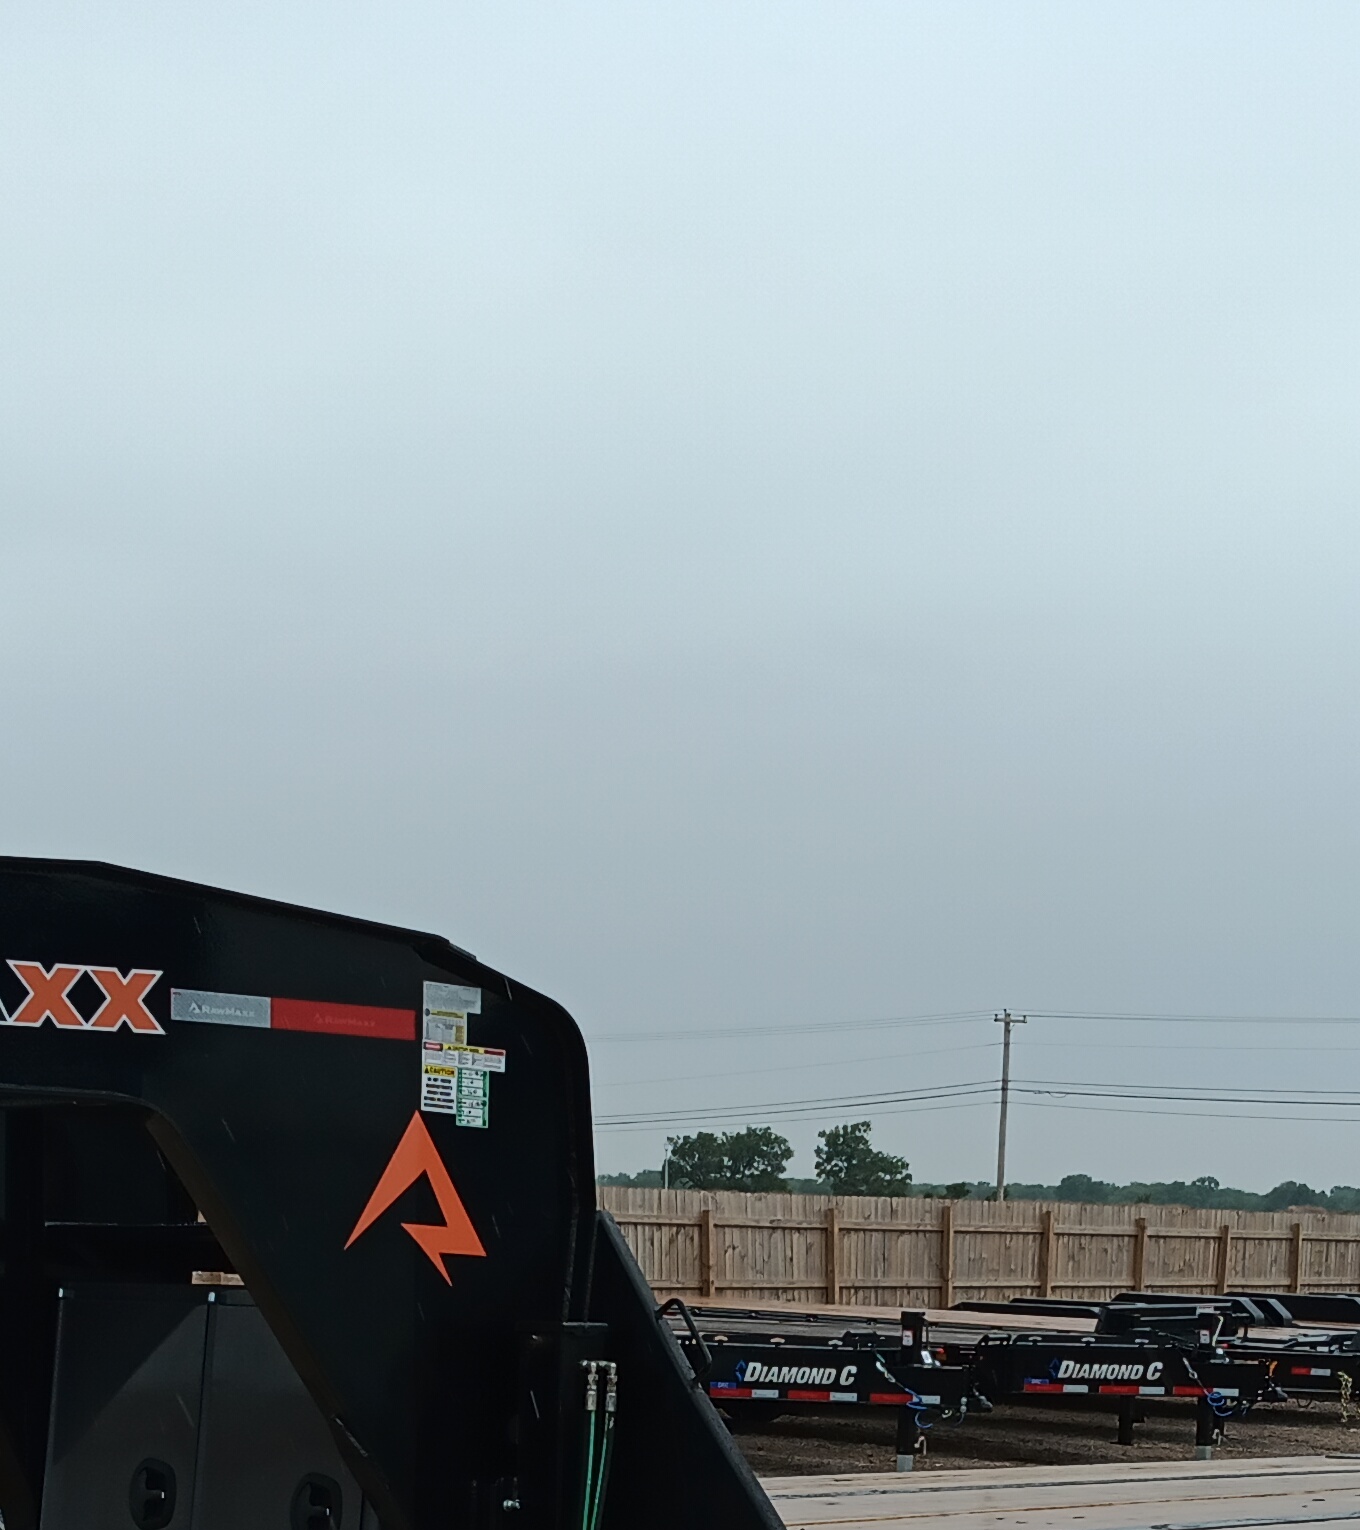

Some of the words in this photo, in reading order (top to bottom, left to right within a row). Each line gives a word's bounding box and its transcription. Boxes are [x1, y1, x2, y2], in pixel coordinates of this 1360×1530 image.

[743, 1361, 837, 1385] DIAMOND
[839, 1365, 858, 1386] C
[1057, 1359, 1144, 1380] DIAMOND
[1146, 1361, 1164, 1381] C
